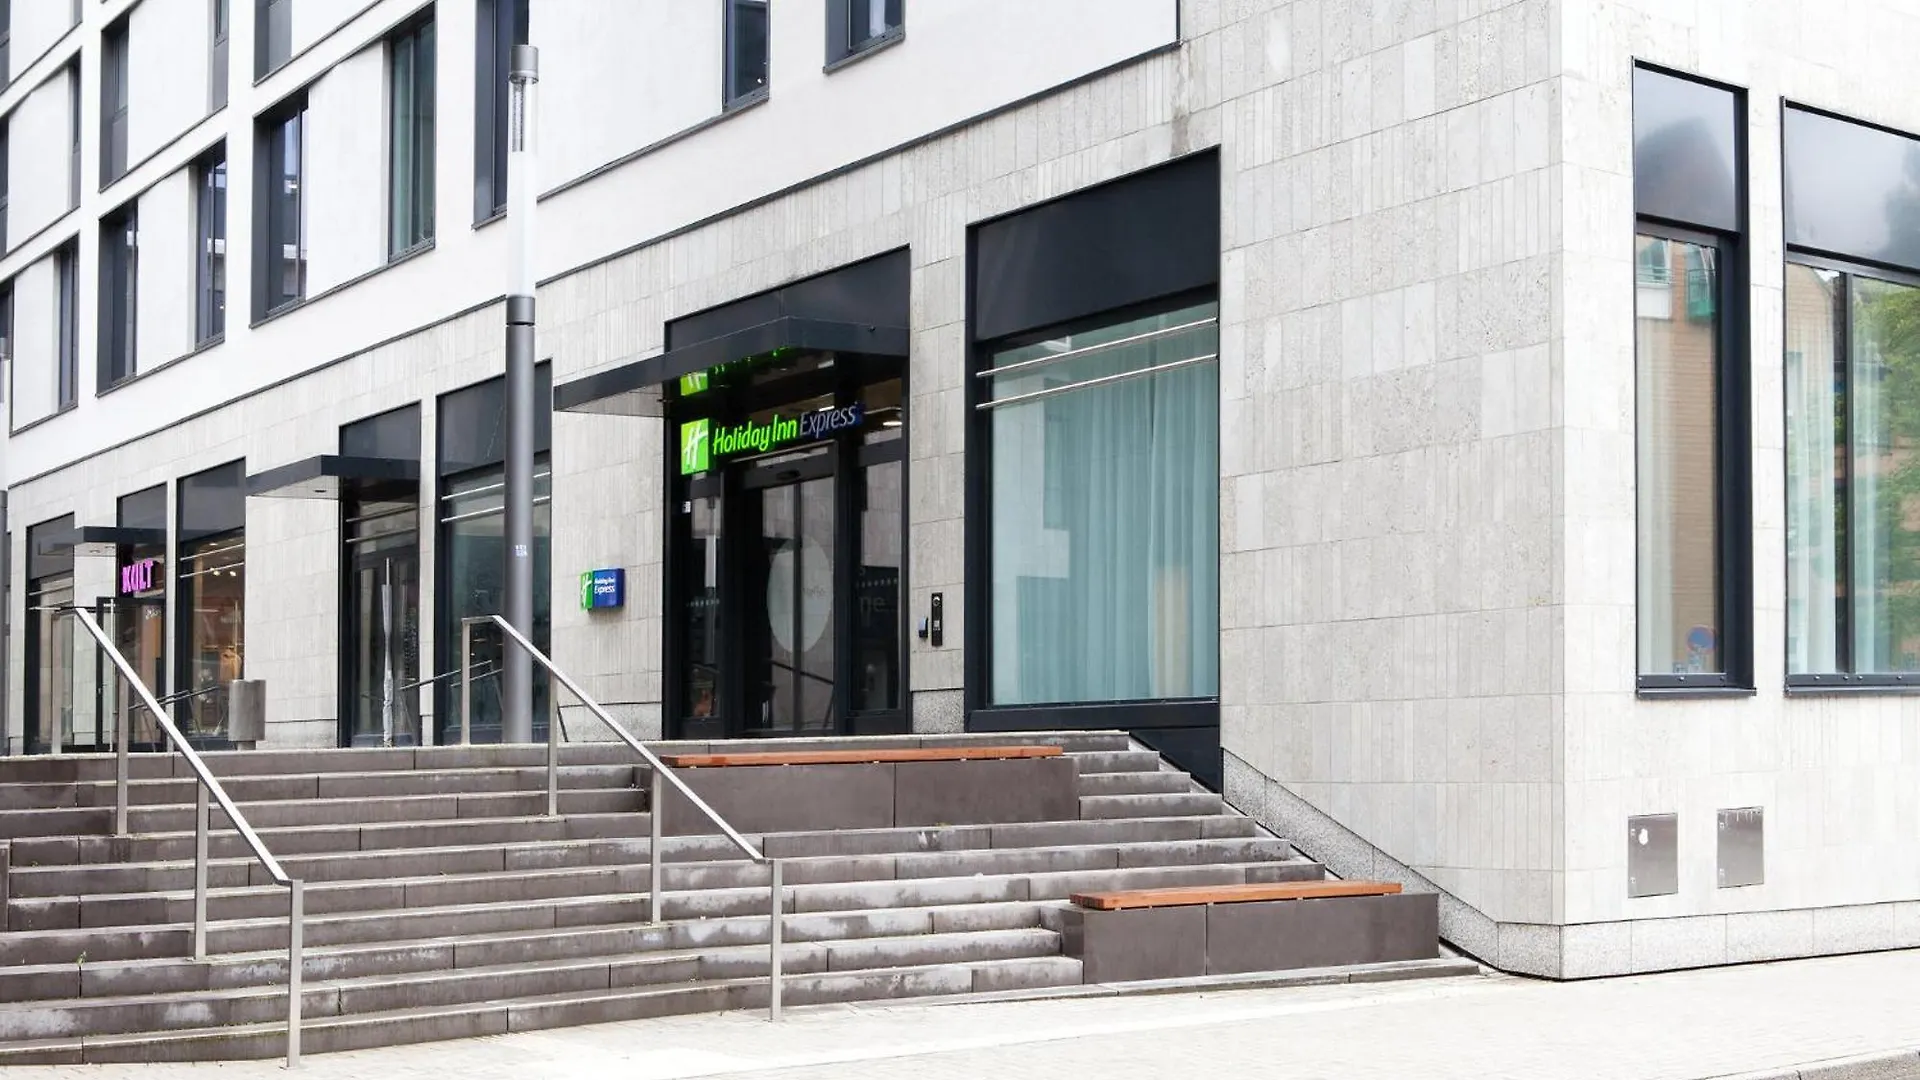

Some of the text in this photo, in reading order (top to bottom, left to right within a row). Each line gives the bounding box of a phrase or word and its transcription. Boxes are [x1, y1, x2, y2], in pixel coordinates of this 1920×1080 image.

[713, 406, 857, 456] Holiday Inn Express
[122, 558, 154, 593] KULT
